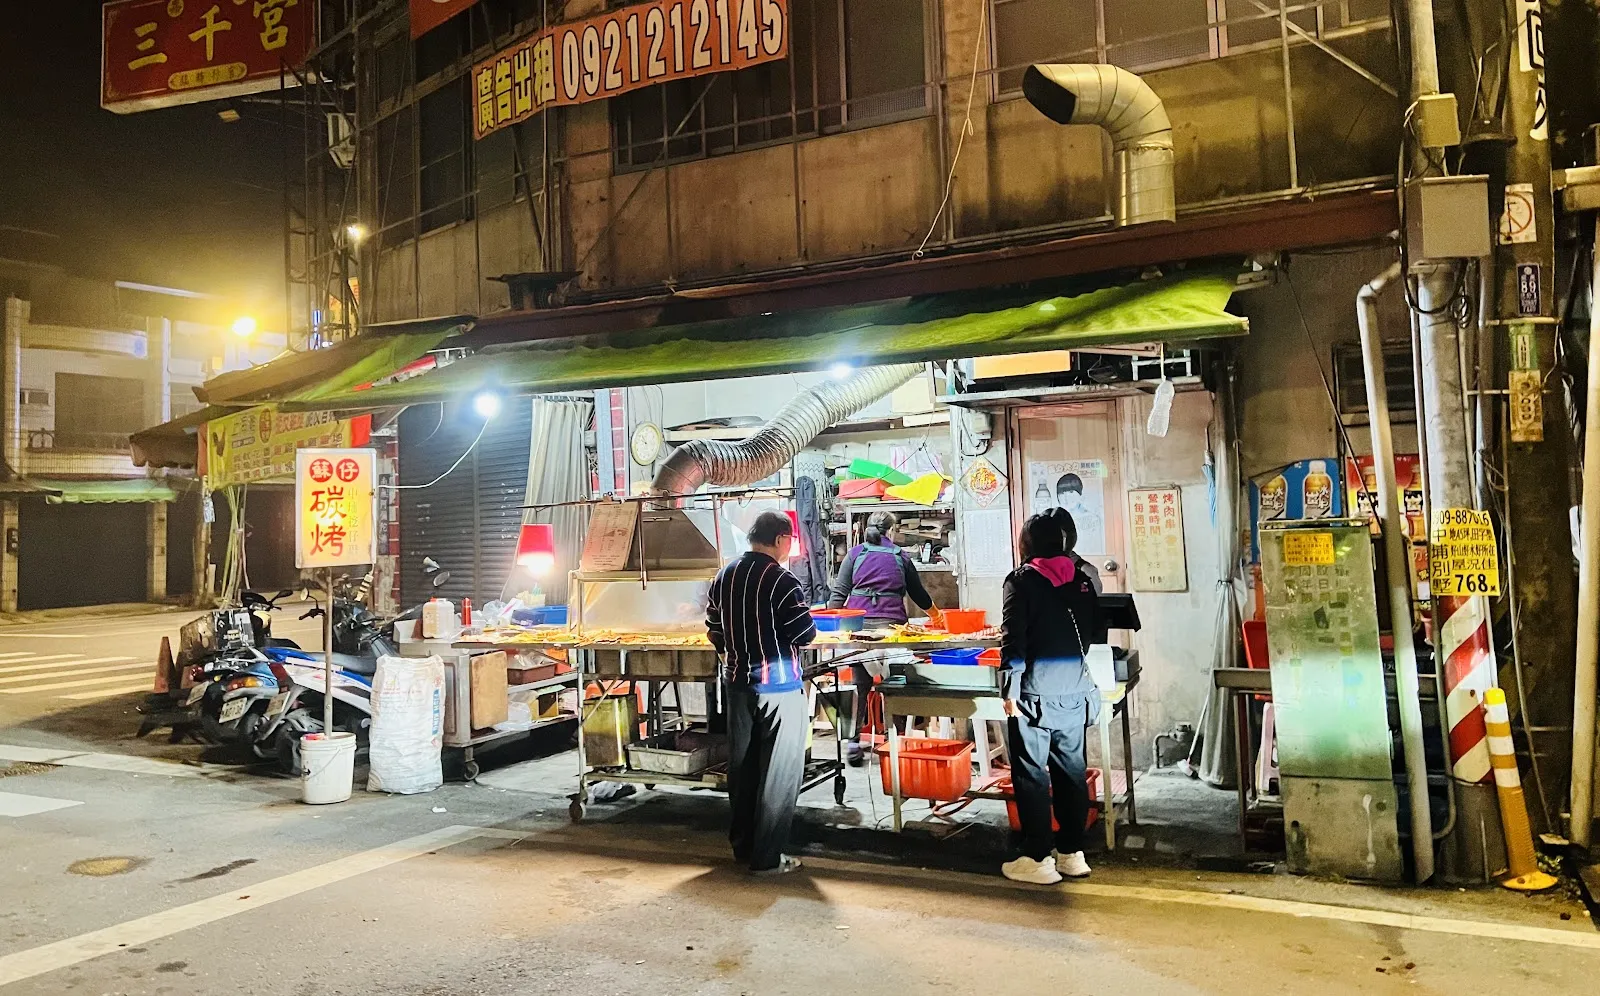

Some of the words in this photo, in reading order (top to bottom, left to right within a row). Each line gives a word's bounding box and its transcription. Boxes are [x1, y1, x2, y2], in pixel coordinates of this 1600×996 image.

[128, 0, 298, 71] 三千宮
[476, 34, 557, 134] 廣告出租
[561, 0, 784, 101] 0921212145
[310, 460, 359, 481] 蘇仔
[309, 485, 347, 557] 碳烤
[1147, 493, 1161, 536] 營業時間
[1162, 493, 1176, 529] 烤肉串
[1432, 527, 1451, 594] 中埔別墅
